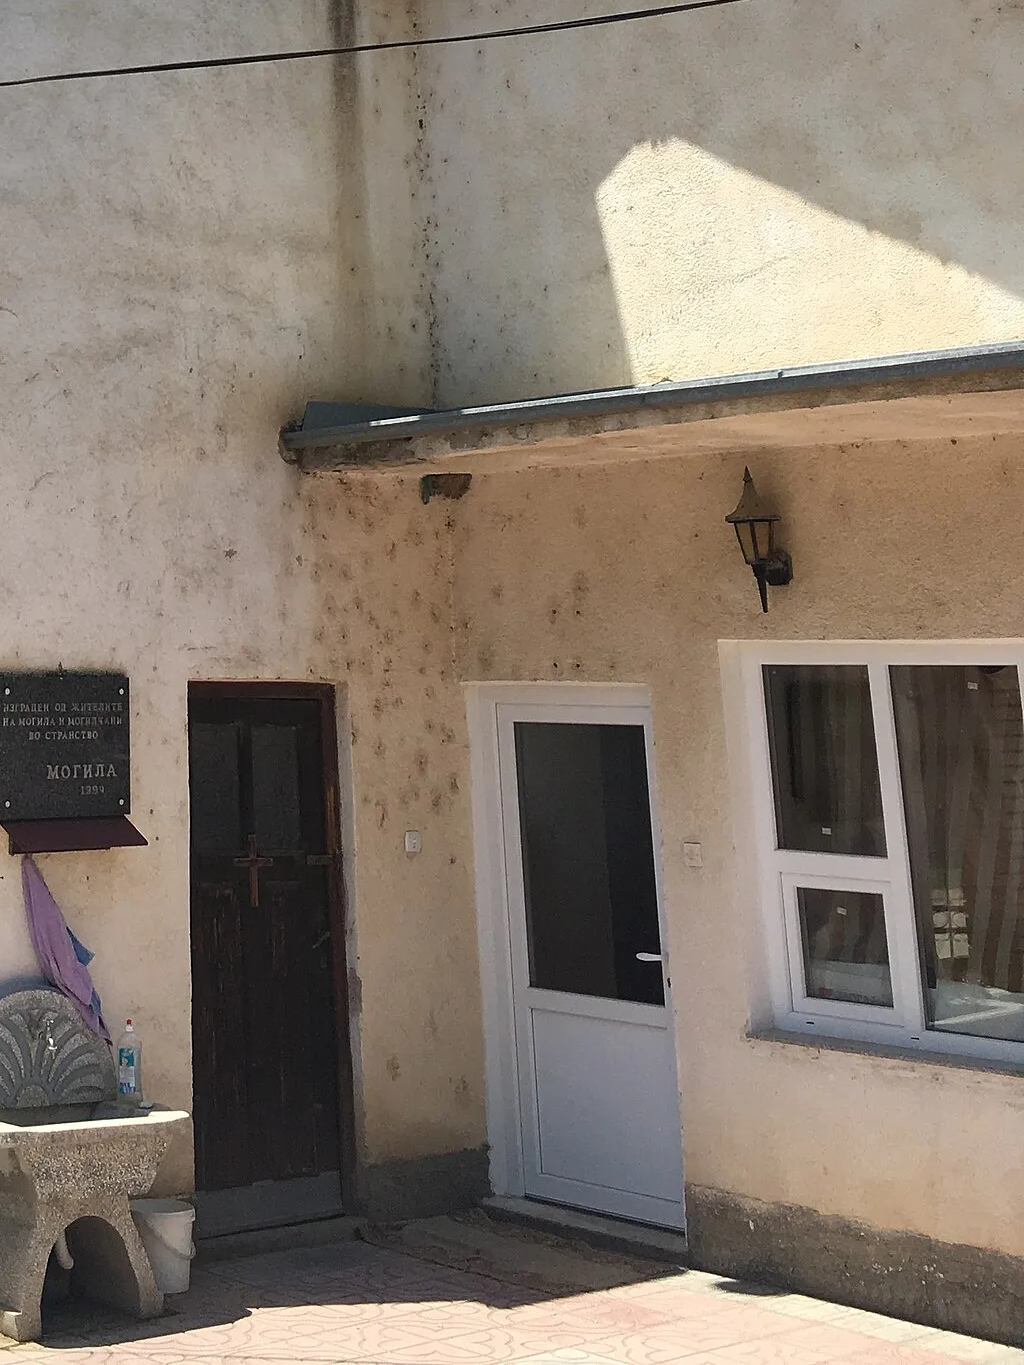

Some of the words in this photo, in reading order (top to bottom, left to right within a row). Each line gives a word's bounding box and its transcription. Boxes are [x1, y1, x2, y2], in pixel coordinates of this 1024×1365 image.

[2, 702, 49, 712] ИЗГРАДЕН
[54, 702, 67, 712] ОД
[71, 702, 123, 711] ЖИТЕЛИТЕ
[2, 717, 16, 726] НА
[18, 717, 55, 726] МОГИЛА
[58, 717, 65, 726] И
[67, 716, 122, 726] МОГИЛЧАНИ
[28, 731, 41, 740] ВО
[45, 730, 99, 740] СТРАНСТВО
[46, 763, 118, 780] МОГИЛА
